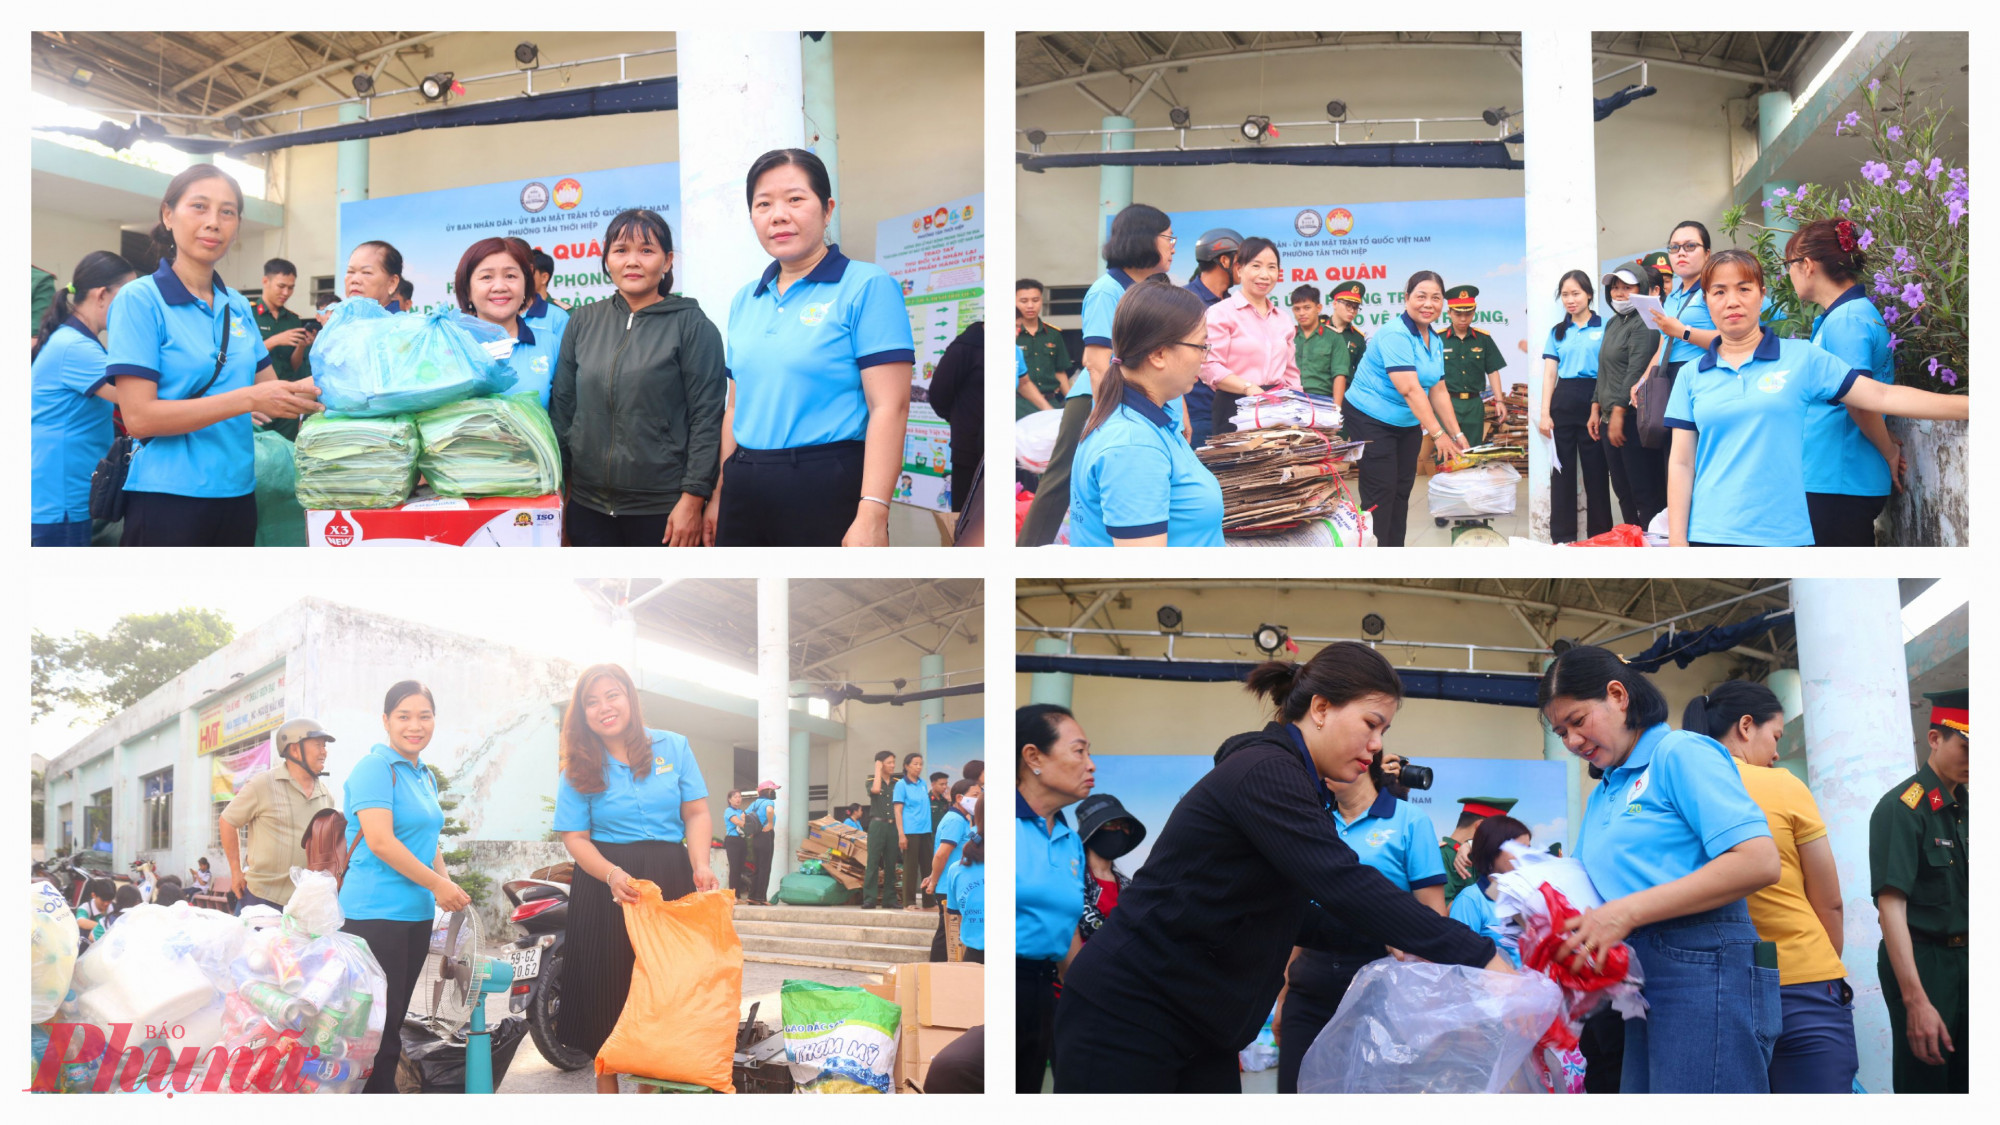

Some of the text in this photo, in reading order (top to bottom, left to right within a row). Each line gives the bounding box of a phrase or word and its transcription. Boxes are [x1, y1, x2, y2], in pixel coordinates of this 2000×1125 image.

[457, 223, 472, 232] BAN
[530, 215, 547, 224] BAN
[553, 238, 606, 260] QUÂ
[1291, 267, 1319, 282] RA
[1325, 262, 1387, 281] QUÂN
[536, 513, 555, 521] ISO
[329, 525, 349, 535] X3
[327, 537, 352, 546] NEW
[1628, 803, 1642, 813] 20
